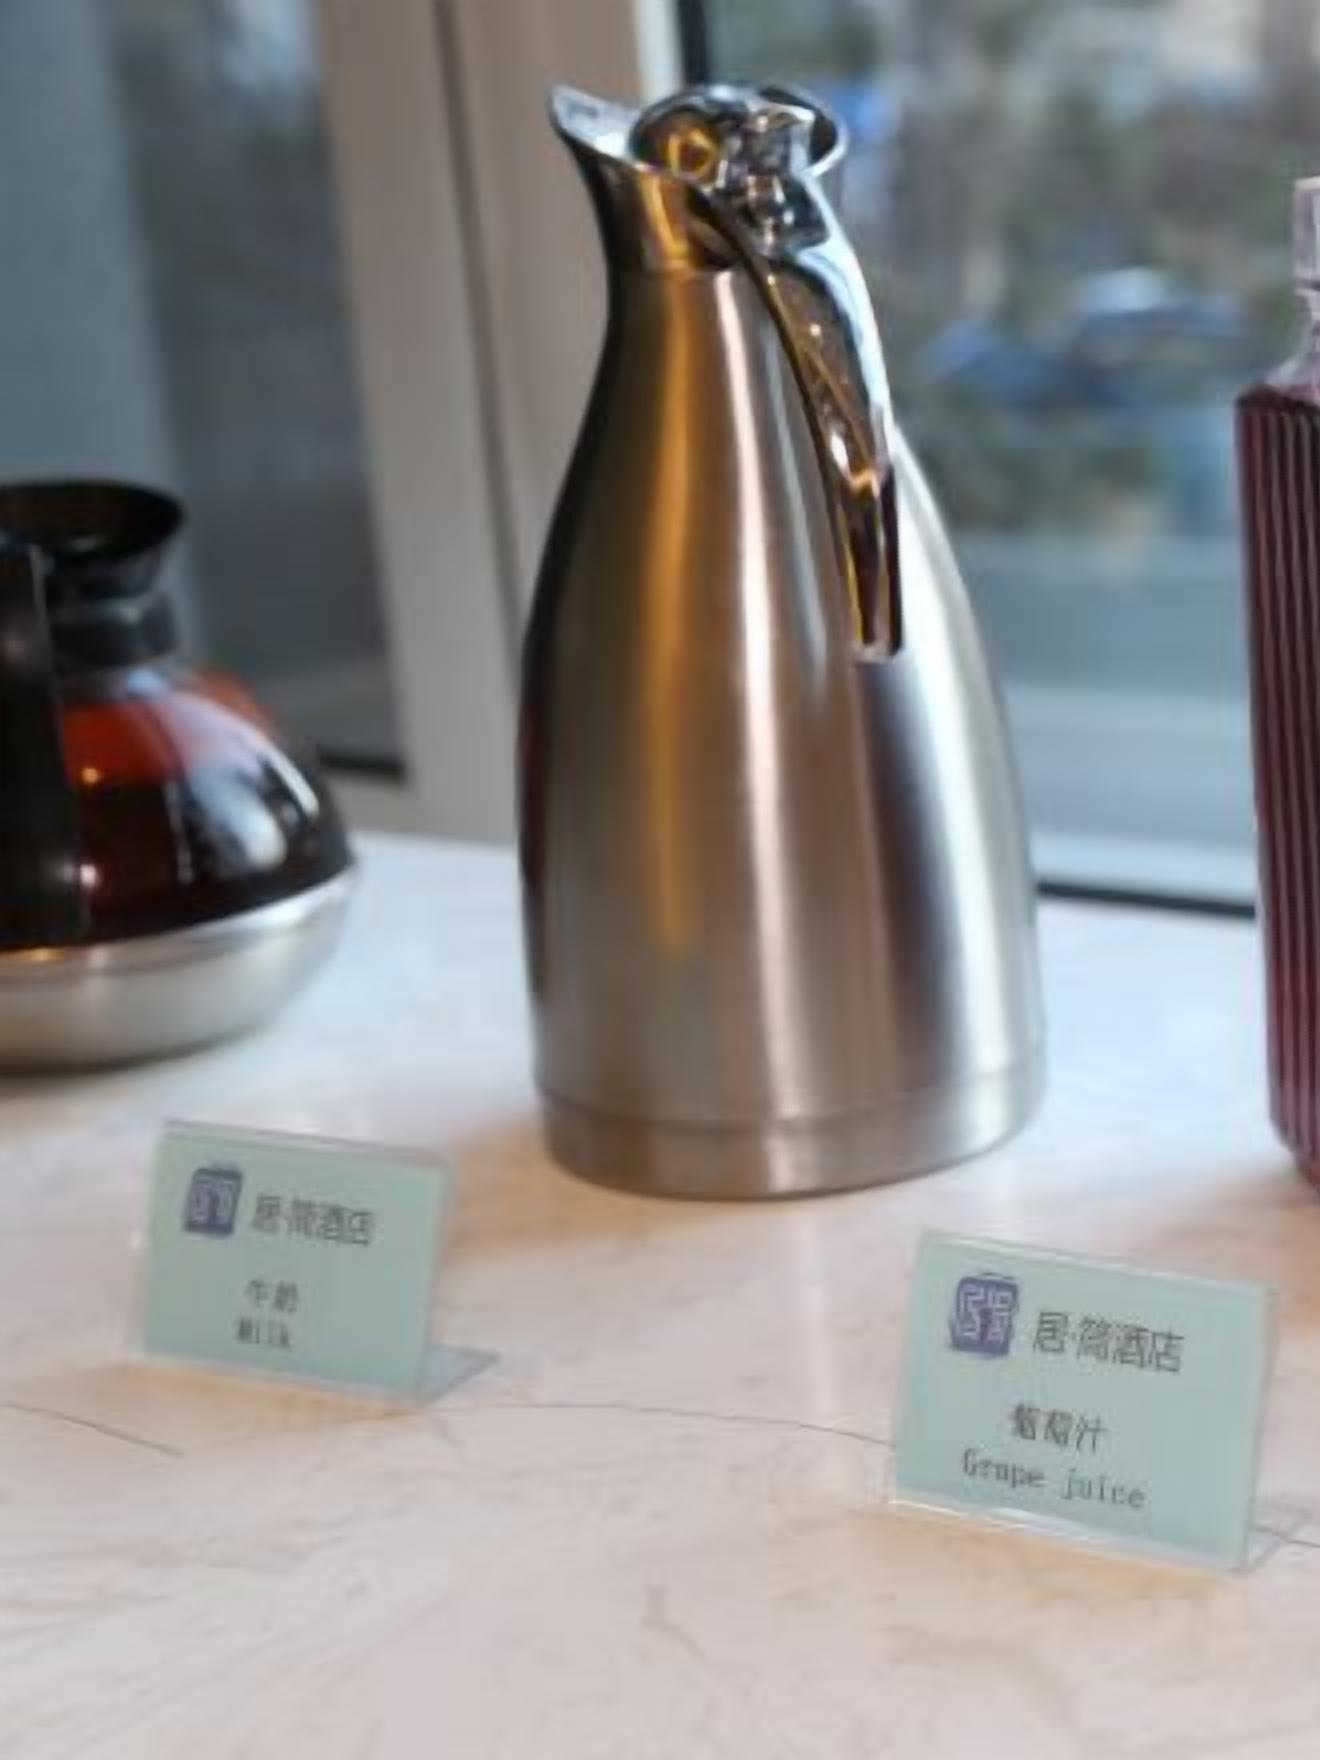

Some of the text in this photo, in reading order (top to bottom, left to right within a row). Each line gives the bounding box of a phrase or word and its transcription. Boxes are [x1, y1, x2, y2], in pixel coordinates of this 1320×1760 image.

[1009, 1402, 1109, 1454] 葡萄汁
[961, 1447, 1146, 1508] Grape juice
